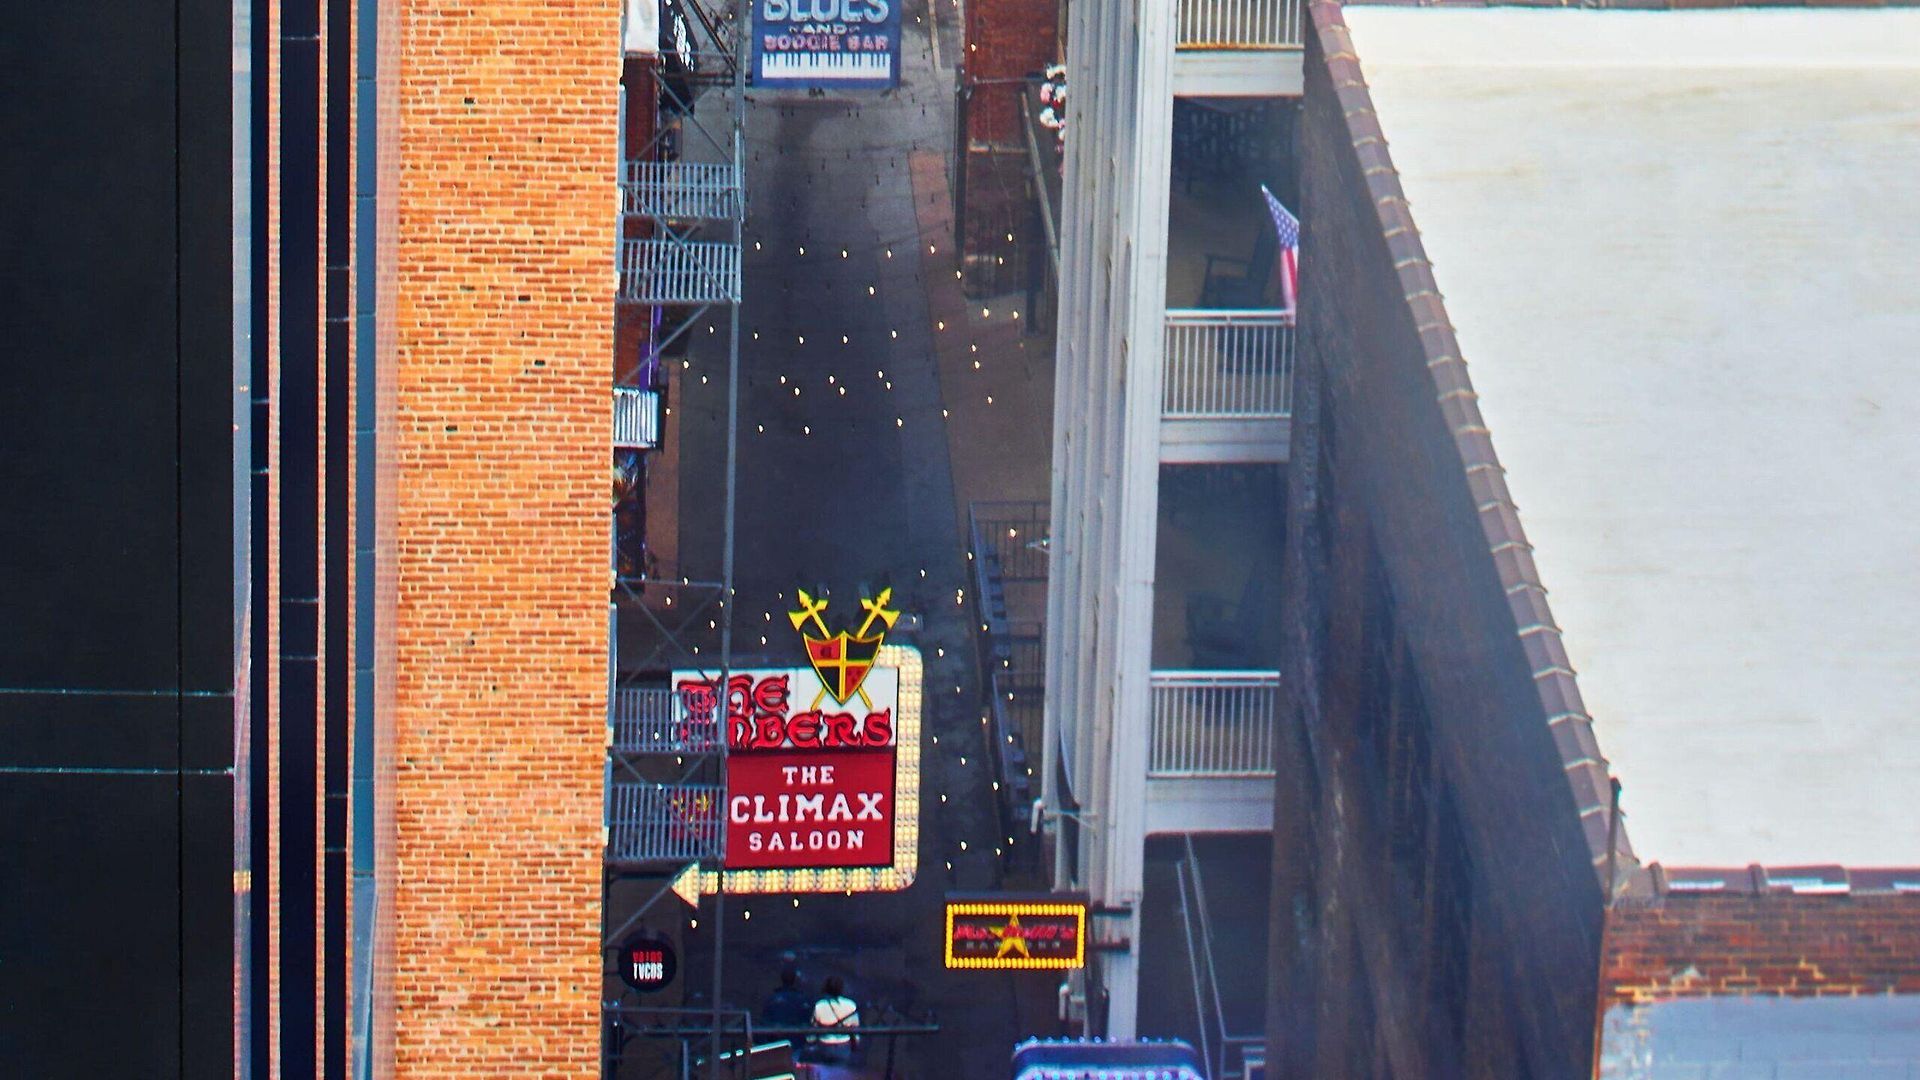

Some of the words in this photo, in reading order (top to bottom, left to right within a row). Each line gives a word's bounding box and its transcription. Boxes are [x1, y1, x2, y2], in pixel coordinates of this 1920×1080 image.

[763, 0, 889, 23] BLUES
[801, 23, 848, 34] AND
[764, 34, 840, 51] BOOGIE
[847, 35, 889, 51] BAR
[782, 765, 835, 785] THE
[730, 792, 884, 824] CLIMAX
[749, 829, 865, 852] SALOON
